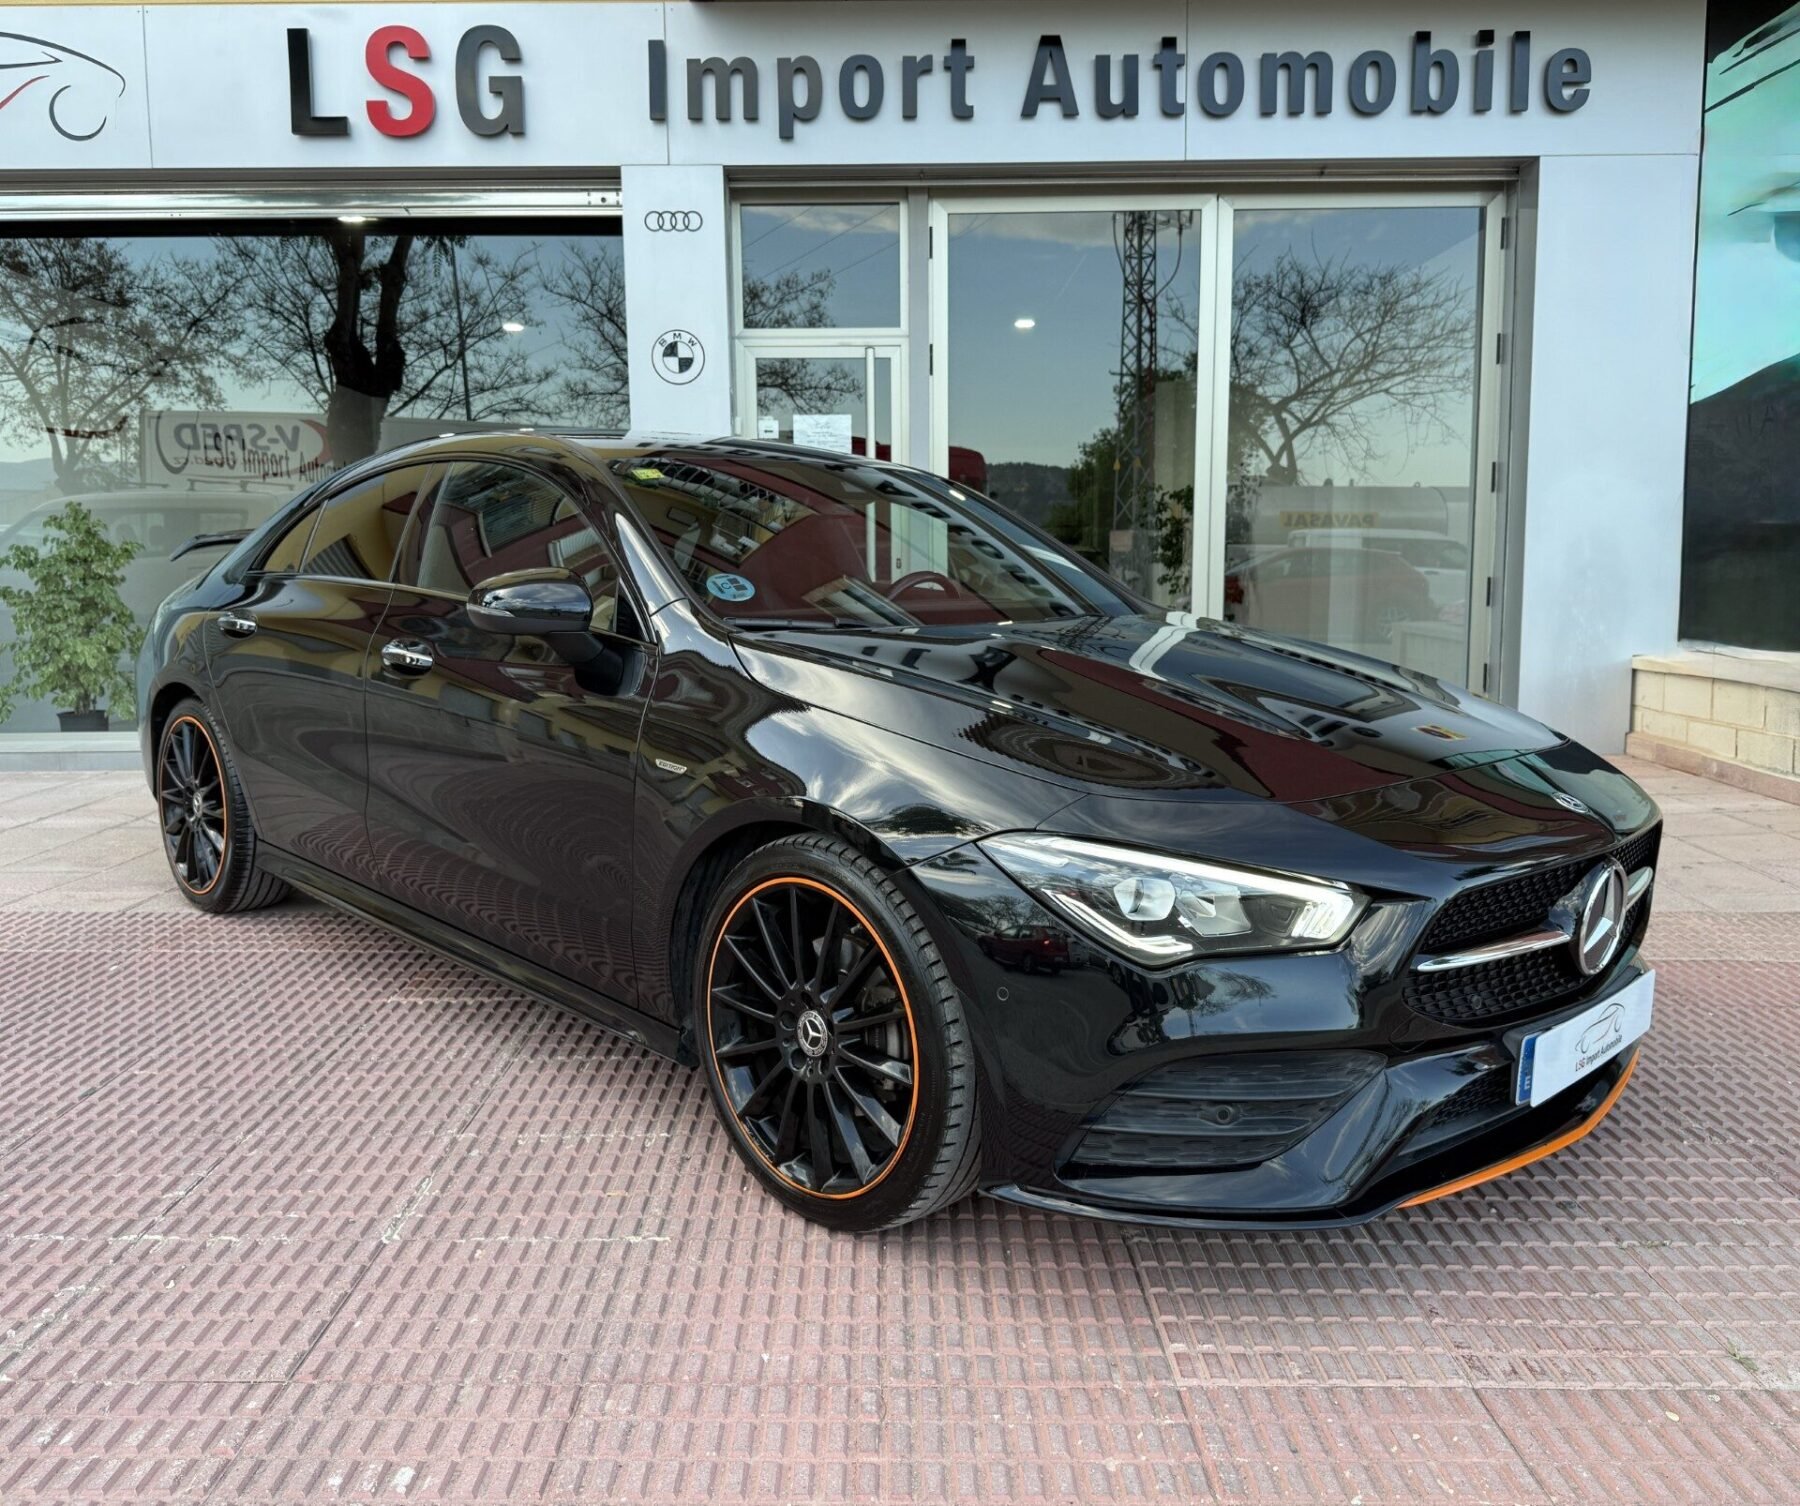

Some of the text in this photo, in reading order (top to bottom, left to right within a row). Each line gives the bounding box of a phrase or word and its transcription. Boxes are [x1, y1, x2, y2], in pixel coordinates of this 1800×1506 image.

[287, 25, 1592, 140] LSG Import Automobile
[659, 332, 697, 348] BMW
[242, 438, 290, 481] Import
[1576, 1057, 1586, 1072] LSG
[1586, 1049, 1601, 1065] Import
